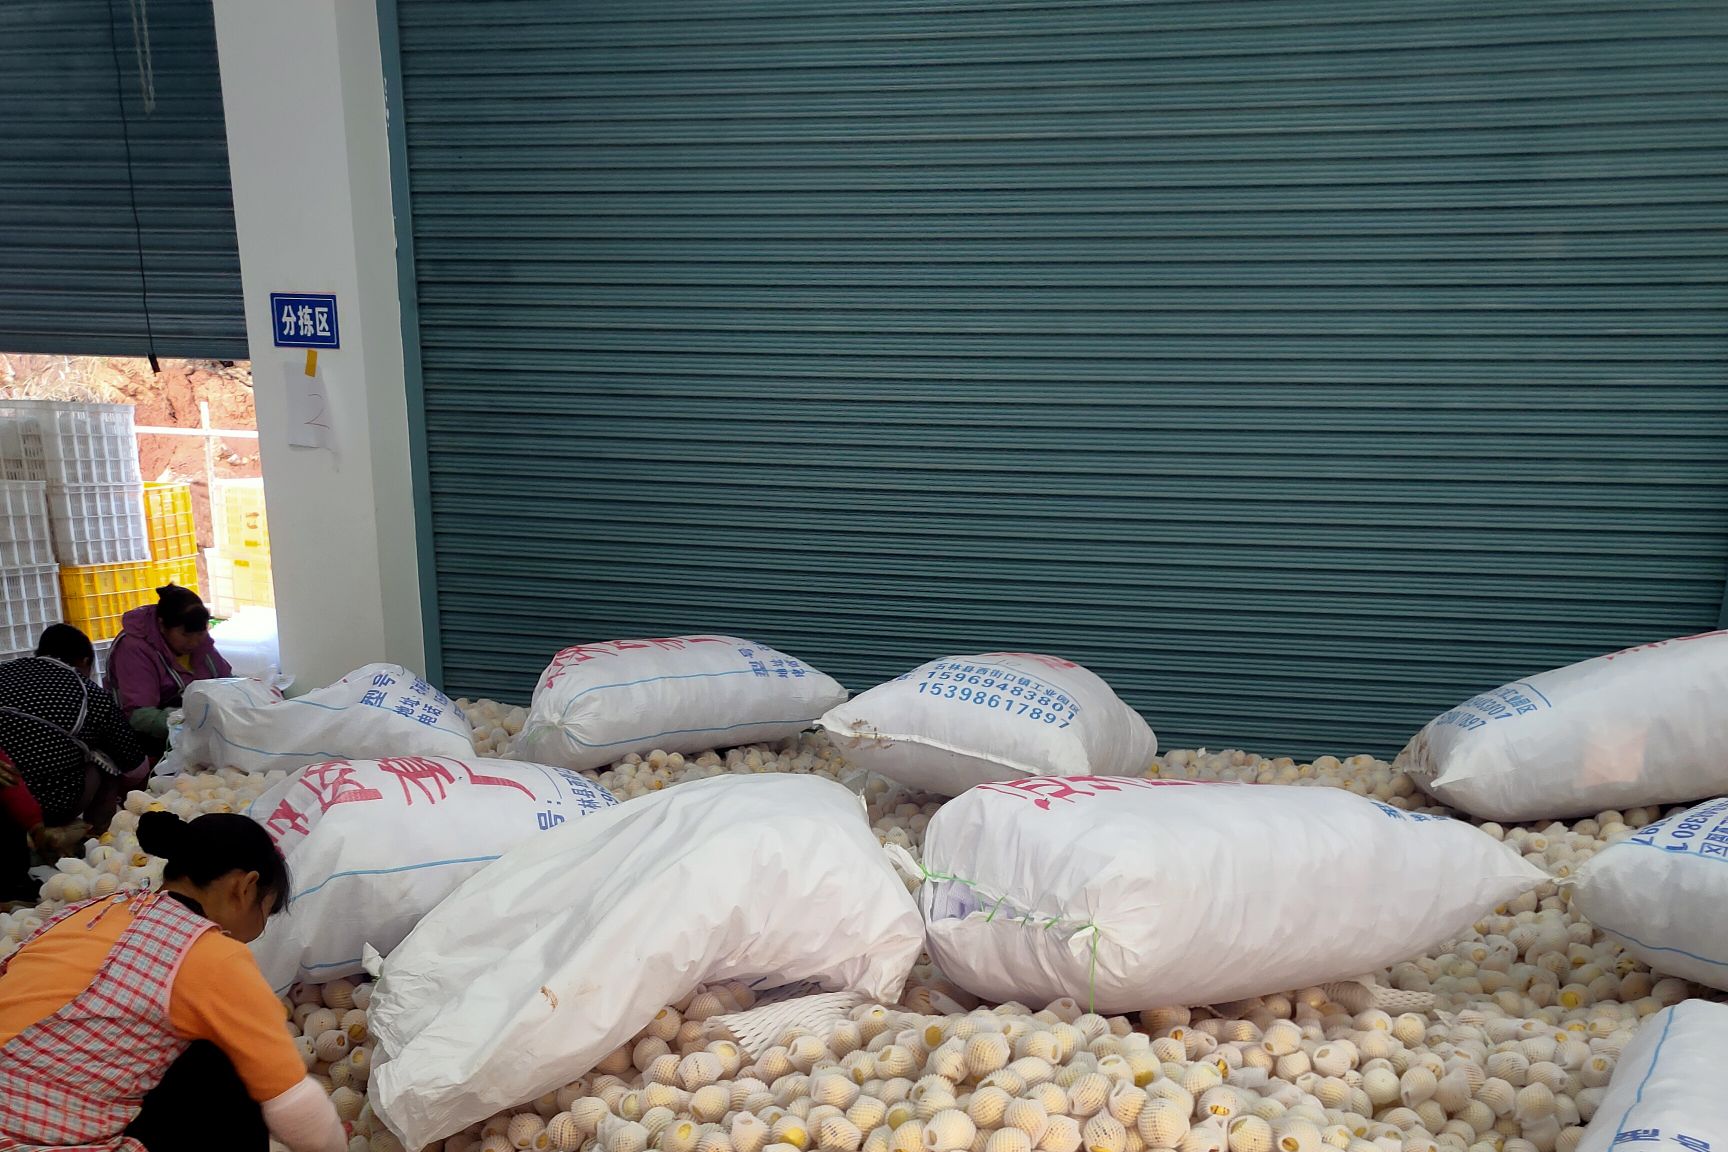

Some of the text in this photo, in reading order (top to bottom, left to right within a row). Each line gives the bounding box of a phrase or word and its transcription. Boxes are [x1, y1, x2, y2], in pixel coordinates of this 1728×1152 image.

[282, 305, 331, 337] 分拣区
[918, 681, 1070, 729] 15398617897
[926, 671, 1076, 721] 15969483801
